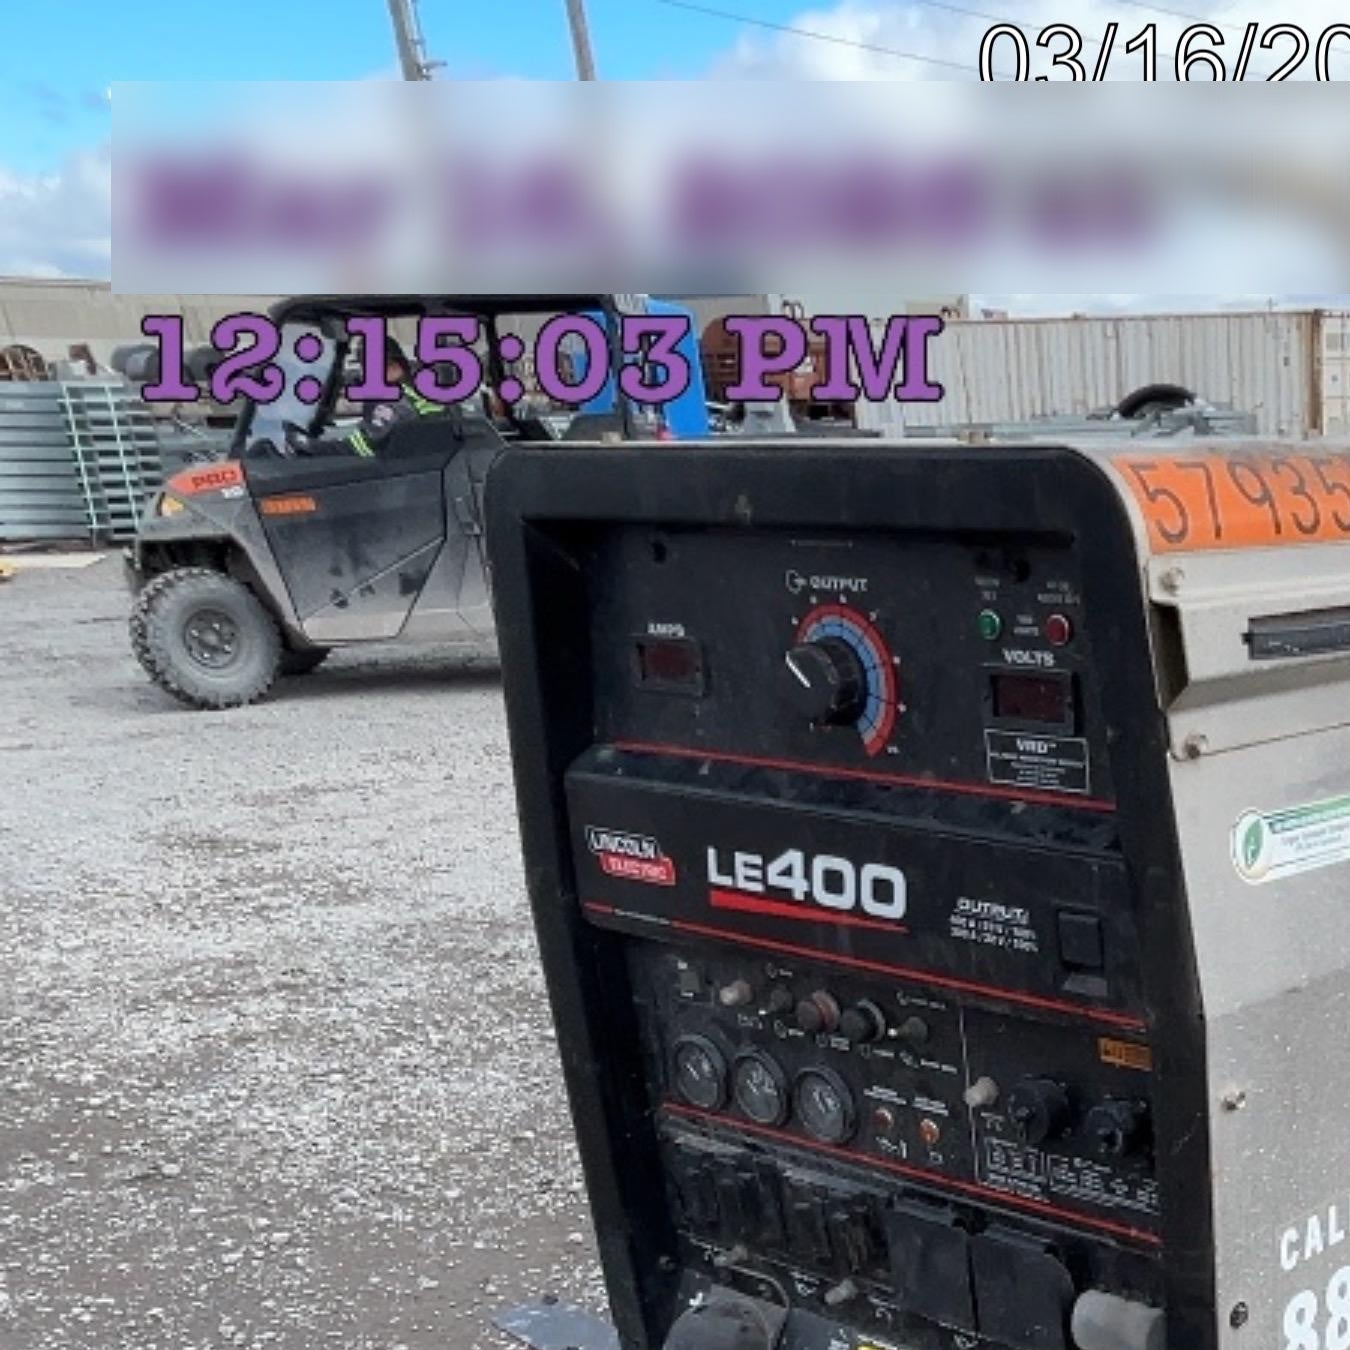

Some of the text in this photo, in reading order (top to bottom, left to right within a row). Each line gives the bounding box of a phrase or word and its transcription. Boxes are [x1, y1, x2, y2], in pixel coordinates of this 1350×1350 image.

[810, 575, 868, 592] OUTPUT
[1002, 649, 1054, 667] VOLTS
[589, 829, 657, 859] LINCOLN
[706, 846, 908, 920] LE400
